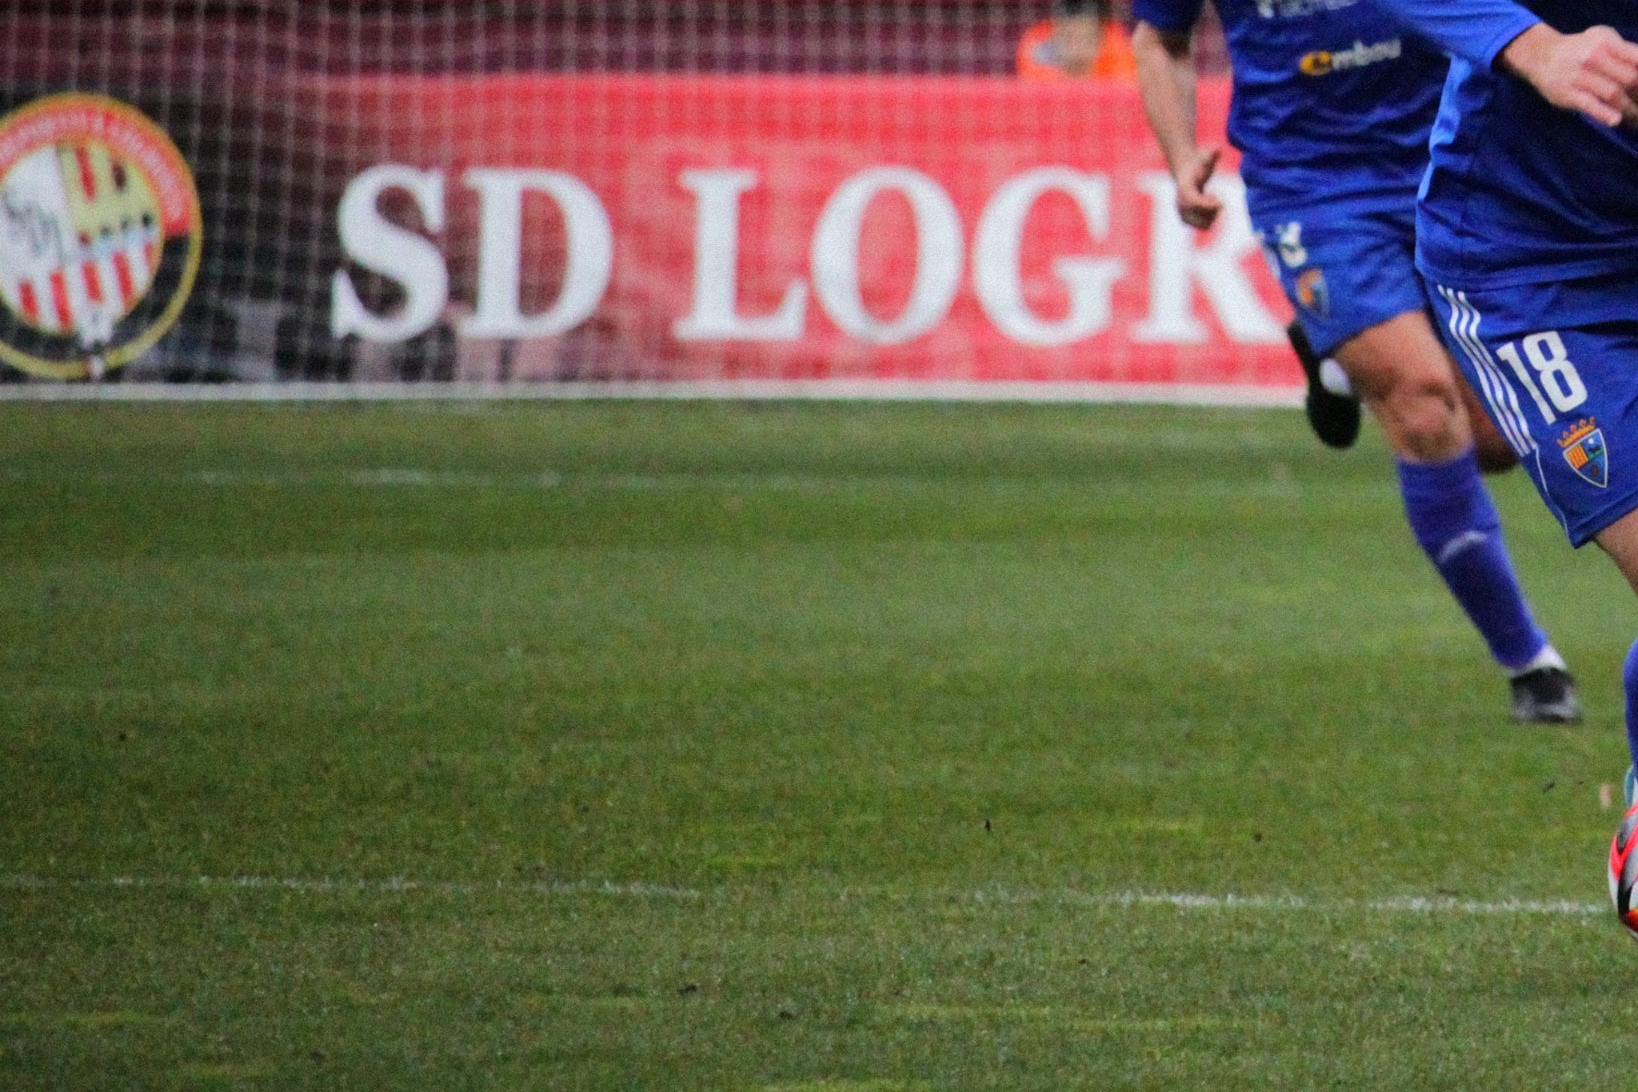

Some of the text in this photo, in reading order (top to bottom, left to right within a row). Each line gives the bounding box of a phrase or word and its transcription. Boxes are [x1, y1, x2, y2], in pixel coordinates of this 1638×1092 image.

[331, 164, 1294, 346] SD LOGR
[1495, 330, 1589, 426] 18
